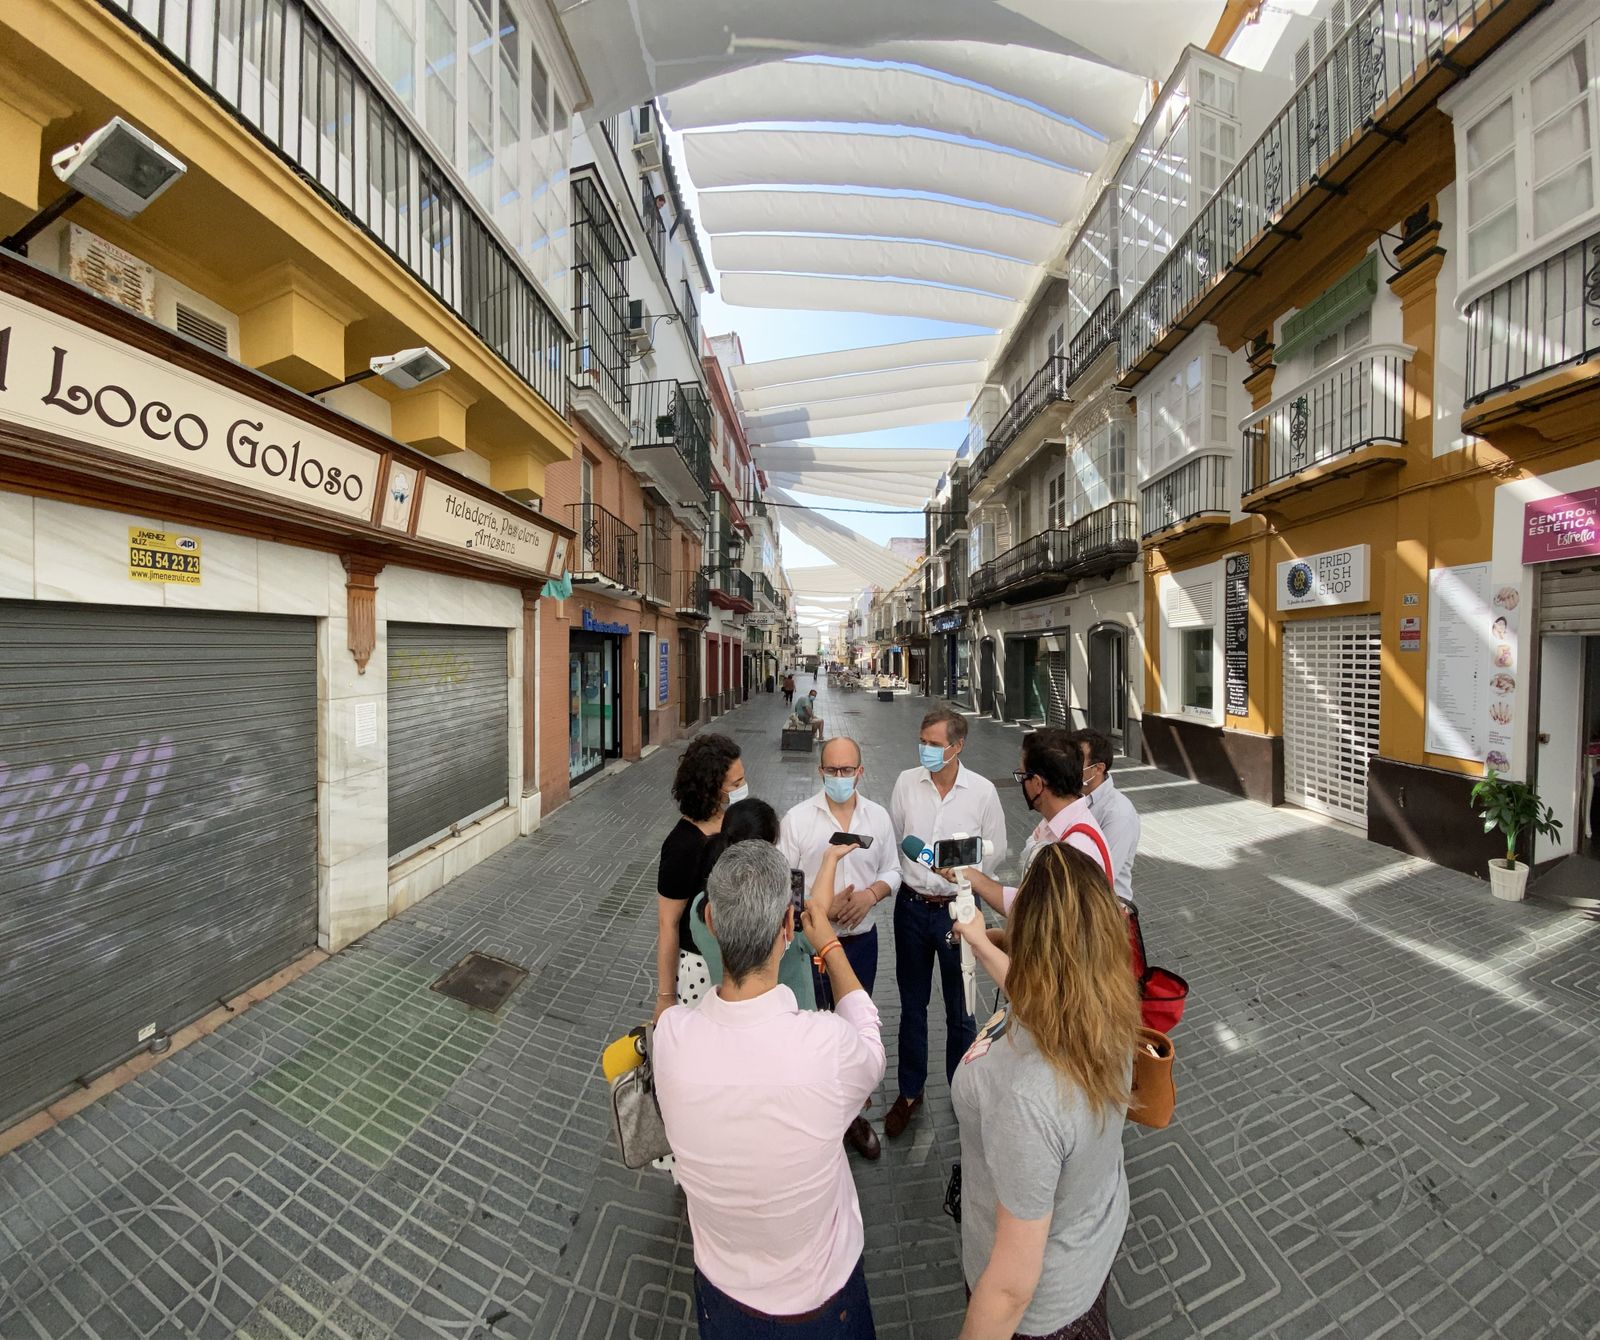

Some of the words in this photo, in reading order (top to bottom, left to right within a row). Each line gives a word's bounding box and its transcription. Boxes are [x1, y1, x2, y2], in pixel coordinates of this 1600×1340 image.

[226, 419, 363, 502] Goloso
[445, 494, 499, 532] Heladería,
[500, 517, 540, 547] Paselería
[1529, 507, 1586, 526] CENTRO
[1528, 517, 1595, 536] ESTÉTICA
[180, 540, 195, 549] API
[474, 529, 516, 554] Artesana
[1557, 529, 1595, 546] Estrella
[131, 549, 153, 567] 956
[155, 552, 169, 569] 54
[171, 554, 185, 571] 23
[187, 557, 199, 572] 23
[1319, 552, 1352, 569] FRIED
[130, 570, 200, 583] www.jimenezruiz.com
[1319, 566, 1352, 582] FISH
[1319, 580, 1352, 596] SHOP
